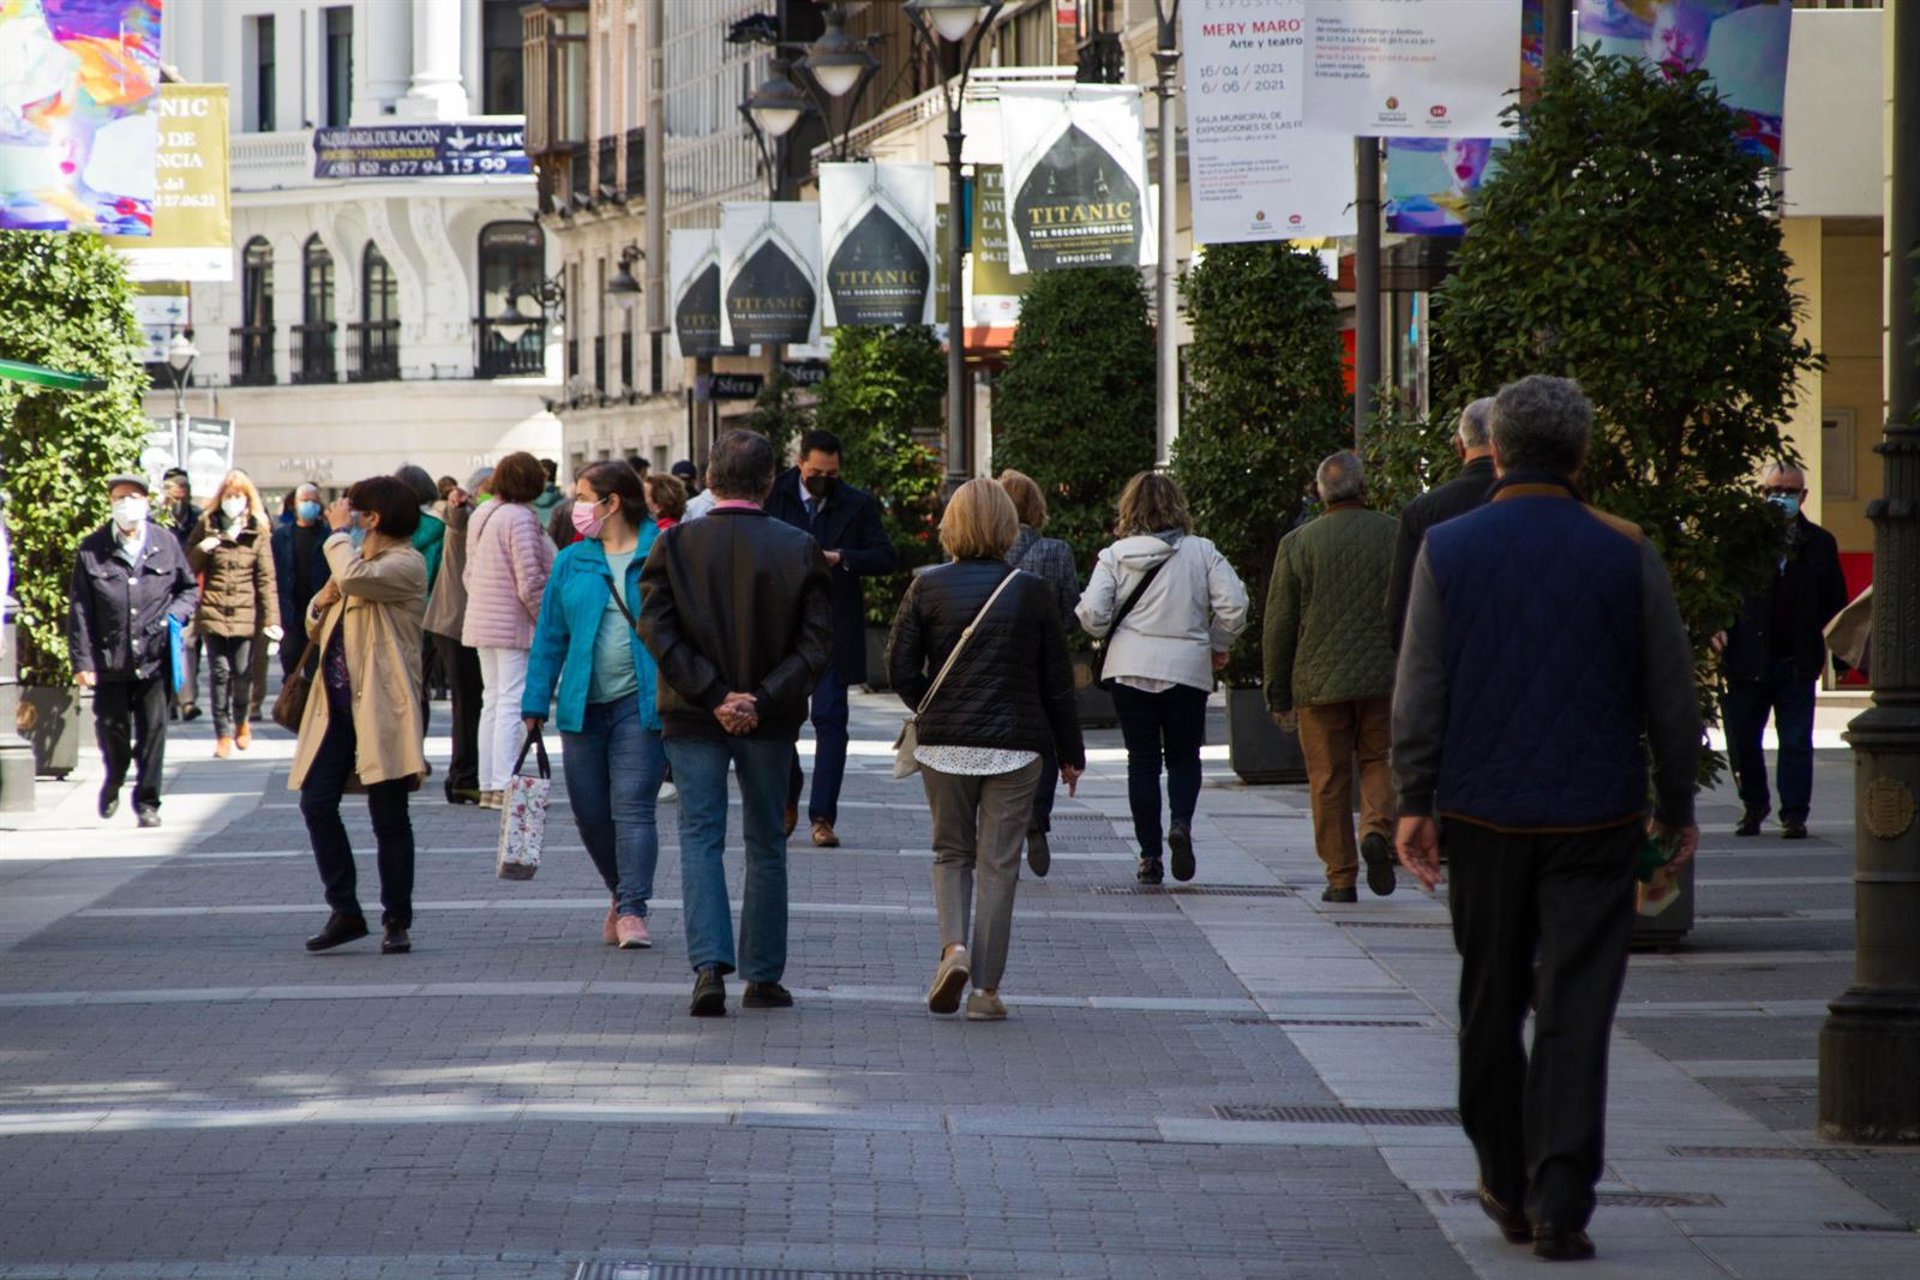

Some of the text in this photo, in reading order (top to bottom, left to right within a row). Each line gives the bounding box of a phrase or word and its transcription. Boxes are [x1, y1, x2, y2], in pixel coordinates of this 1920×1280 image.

[1203, 18, 1304, 36] MERY MARO
[1229, 37, 1303, 49] Arte y teatro
[1254, 63, 1284, 74] 2021
[1255, 80, 1284, 91] 2021
[1270, 111, 1281, 119] DE
[168, 131, 197, 146] DE
[389, 161, 418, 174] 677
[479, 157, 507, 171] 99
[1028, 201, 1132, 225] TITANIC
[983, 217, 1003, 229] LA
[1030, 223, 1133, 239] THE RECONSTRUCTION
[1056, 252, 1112, 264] EXPOSICIÓN
[837, 270, 919, 286] TITANIC
[733, 296, 807, 310] TITANIC
